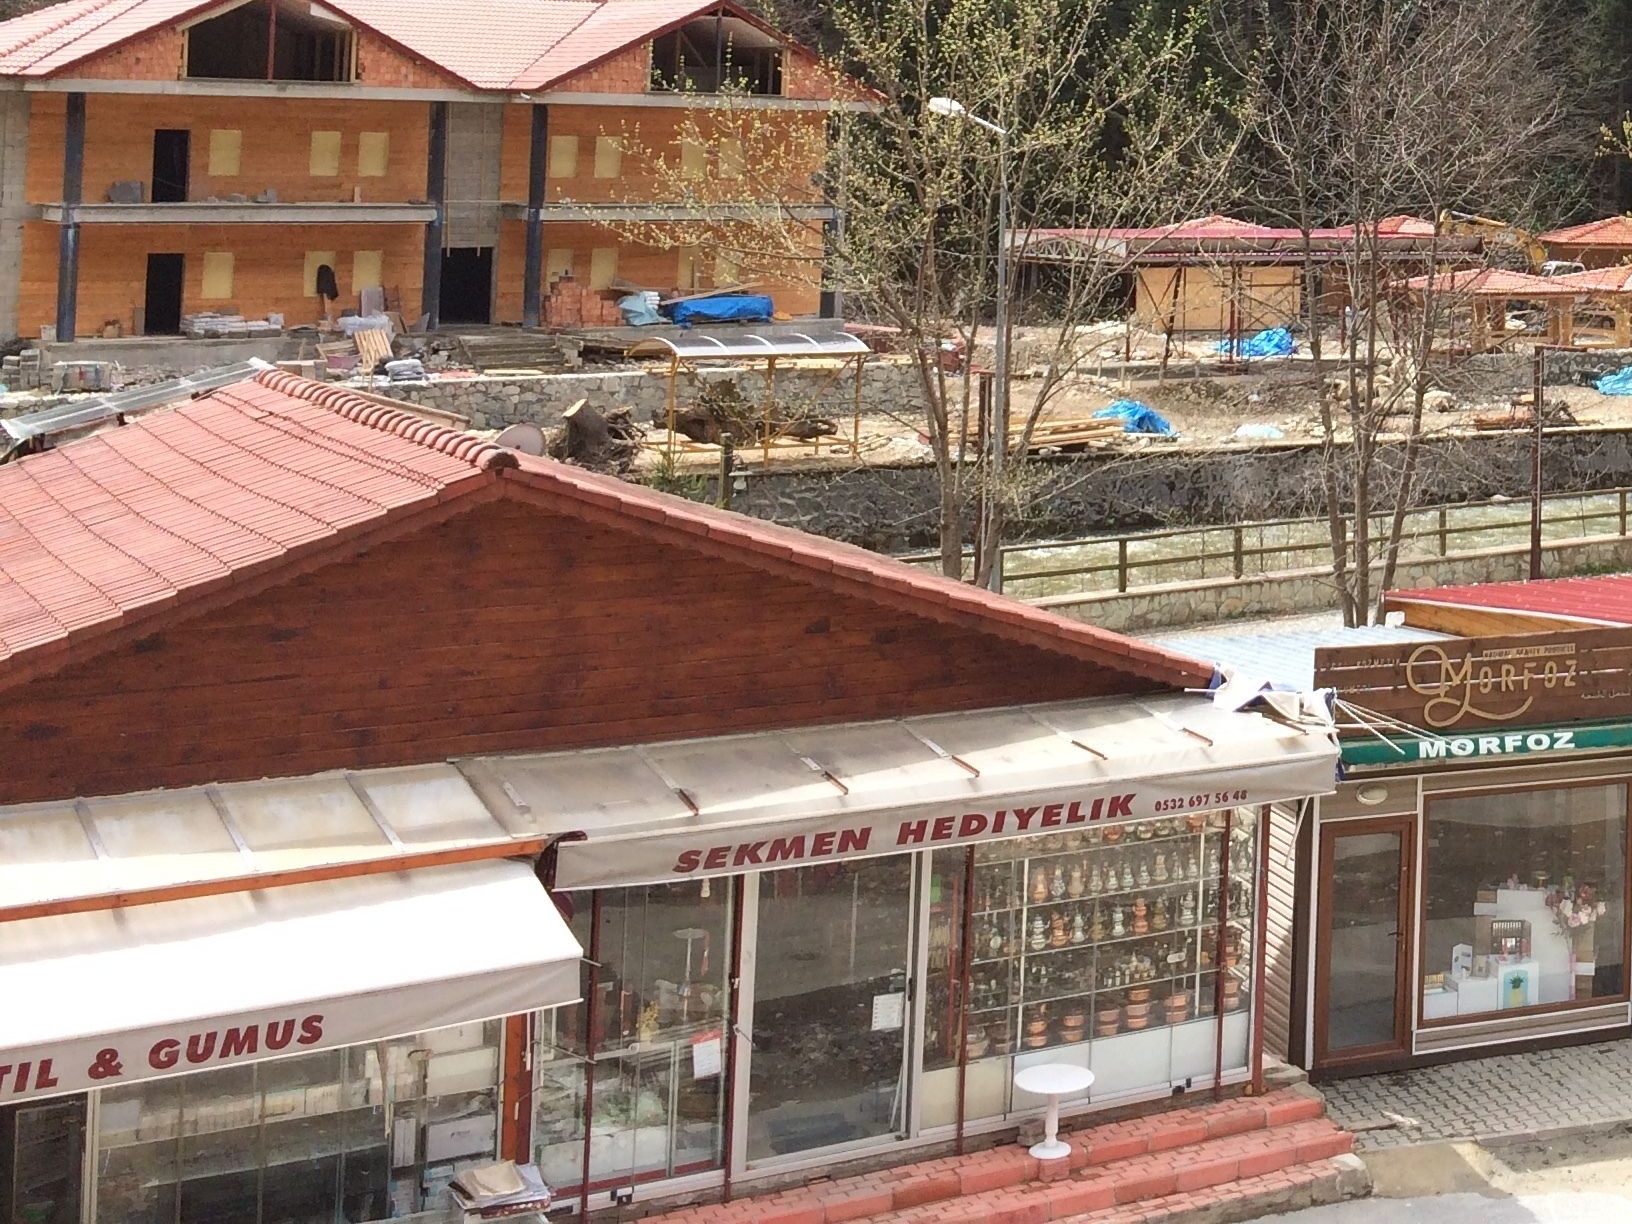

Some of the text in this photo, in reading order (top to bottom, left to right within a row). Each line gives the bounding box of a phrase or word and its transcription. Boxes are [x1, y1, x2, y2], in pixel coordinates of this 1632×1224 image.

[1406, 644, 1578, 728] MORFOZ
[1419, 731, 1575, 759] MORFOZ
[672, 789, 1247, 873] SEKMEN HEDIYELIK 0532 697 56 48
[88, 1048, 123, 1080] &
[148, 1014, 324, 1070] GUMUS
